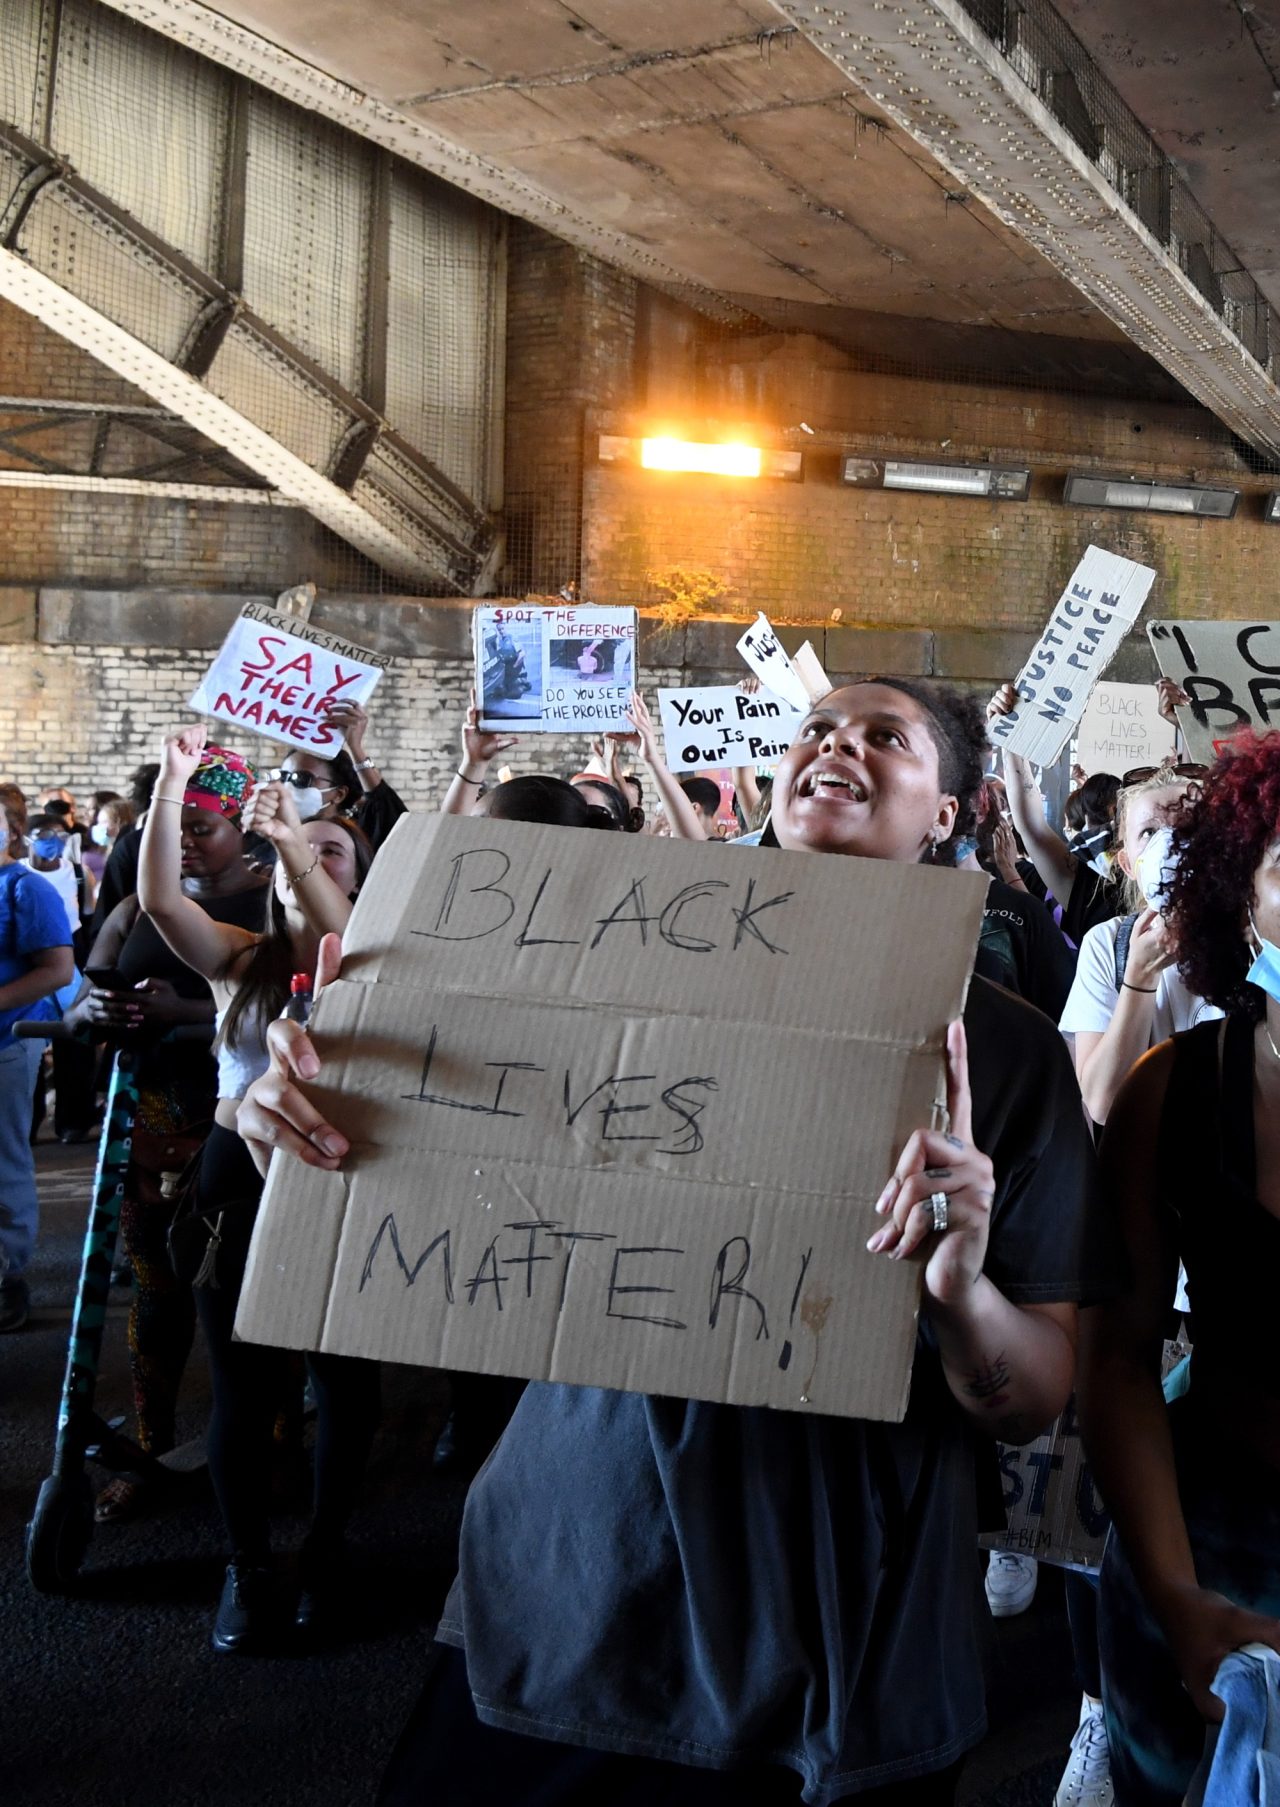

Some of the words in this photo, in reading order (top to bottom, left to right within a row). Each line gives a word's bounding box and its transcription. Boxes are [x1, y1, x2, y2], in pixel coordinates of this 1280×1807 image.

[494, 609, 534, 623] SPOT
[542, 610, 577, 621] THE
[557, 624, 635, 637] DIFFERENCE
[243, 604, 285, 630] BLACK
[289, 622, 331, 648] LIVES
[332, 642, 391, 671] MATTER
[1017, 583, 1093, 703] JUSTICE
[242, 636, 363, 695] SAY
[1038, 686, 1073, 724] NO
[1067, 591, 1121, 671] PEACE
[240, 669, 338, 716] THEIR
[546, 688, 565, 702] DO
[573, 689, 595, 700] YOU
[598, 687, 626, 699] SEE
[1096, 694, 1144, 717] BLACK
[213, 692, 338, 744] NAMES
[540, 705, 569, 720] THE
[670, 699, 724, 727] Your
[735, 696, 780, 720] Pain
[717, 728, 744, 744] Is
[1110, 721, 1147, 738] LIVES
[681, 744, 727, 763] Our
[1094, 739, 1152, 760] MATTER!
[410, 848, 796, 957] BLACK
[400, 1024, 720, 1155] LIVES
[357, 1212, 813, 1371] MATTER!
